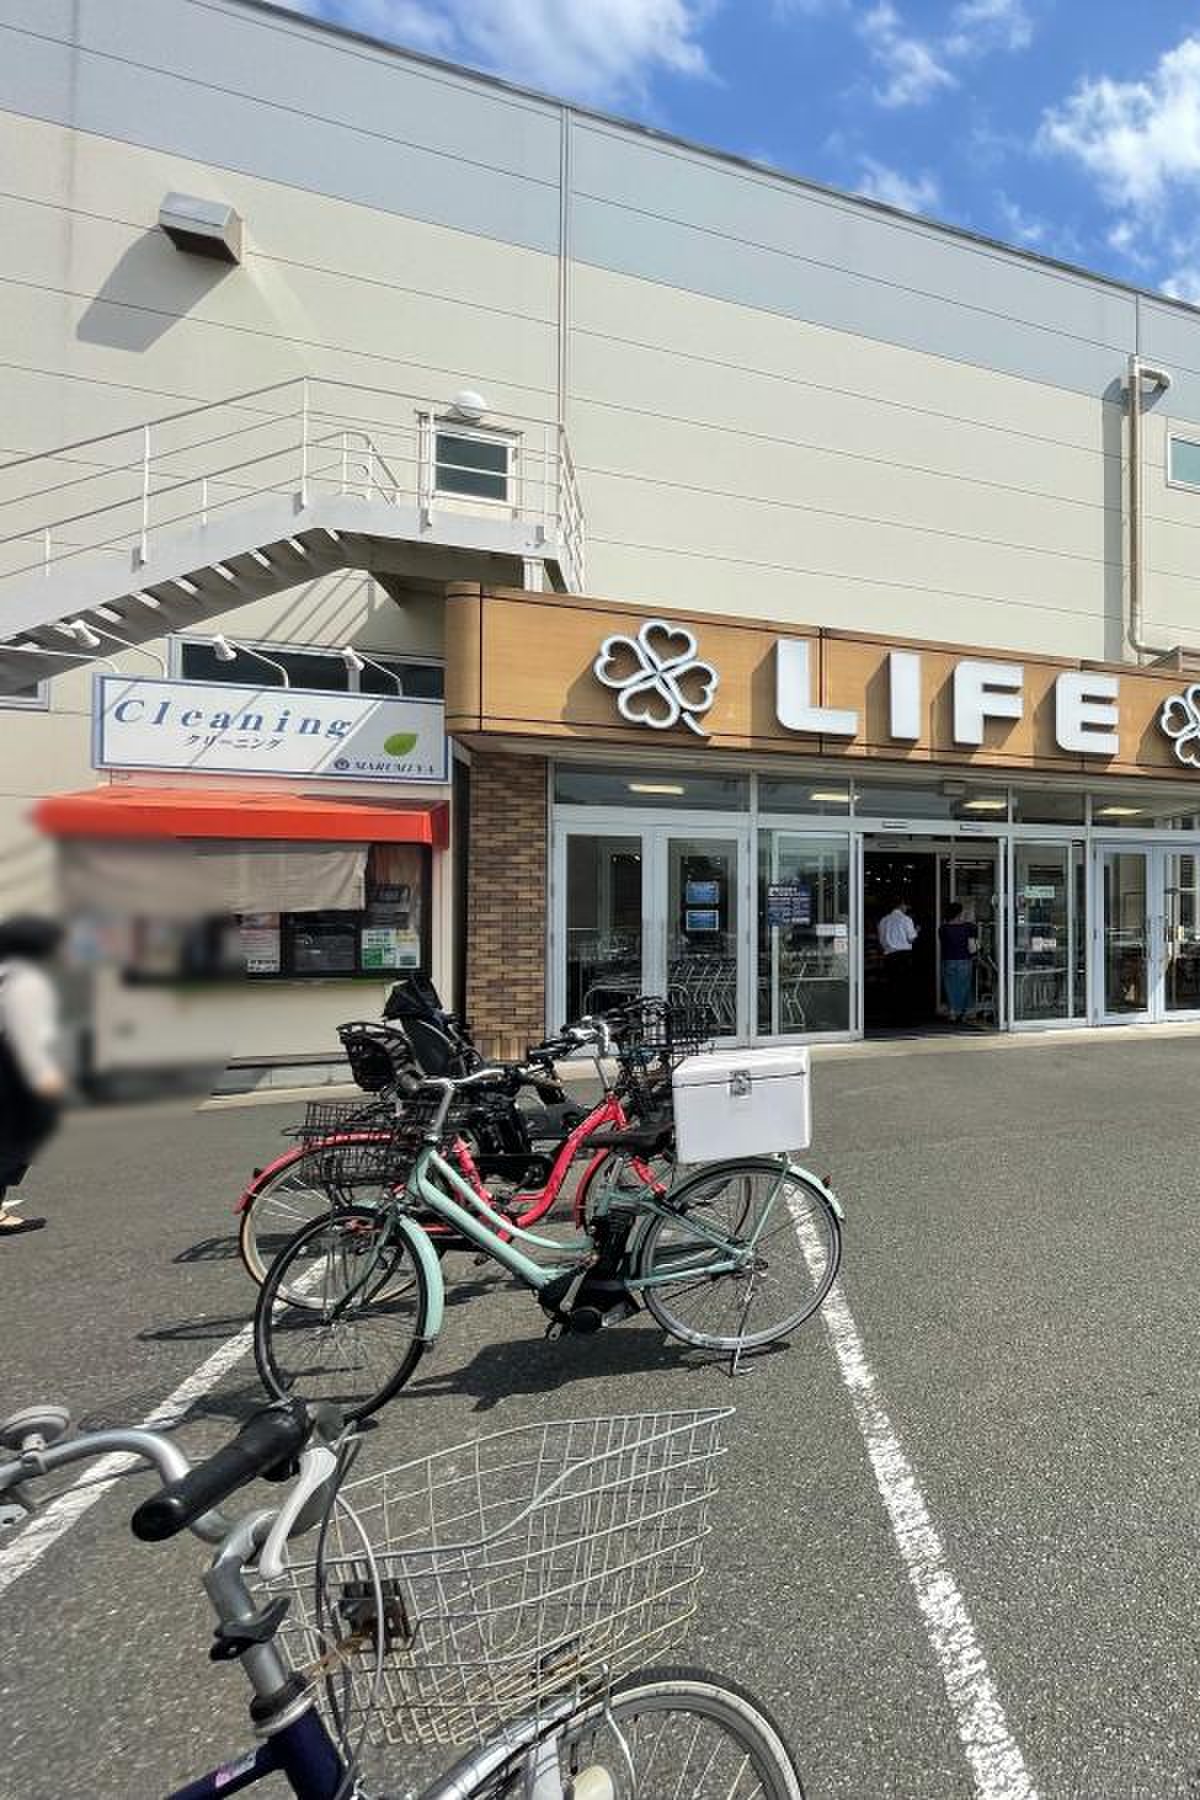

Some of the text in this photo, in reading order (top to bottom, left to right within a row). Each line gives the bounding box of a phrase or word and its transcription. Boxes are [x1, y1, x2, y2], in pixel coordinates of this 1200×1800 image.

[776, 638, 1119, 755] LIFE
[113, 699, 352, 739] Cleaning
[184, 733, 284, 751] クリーニング
